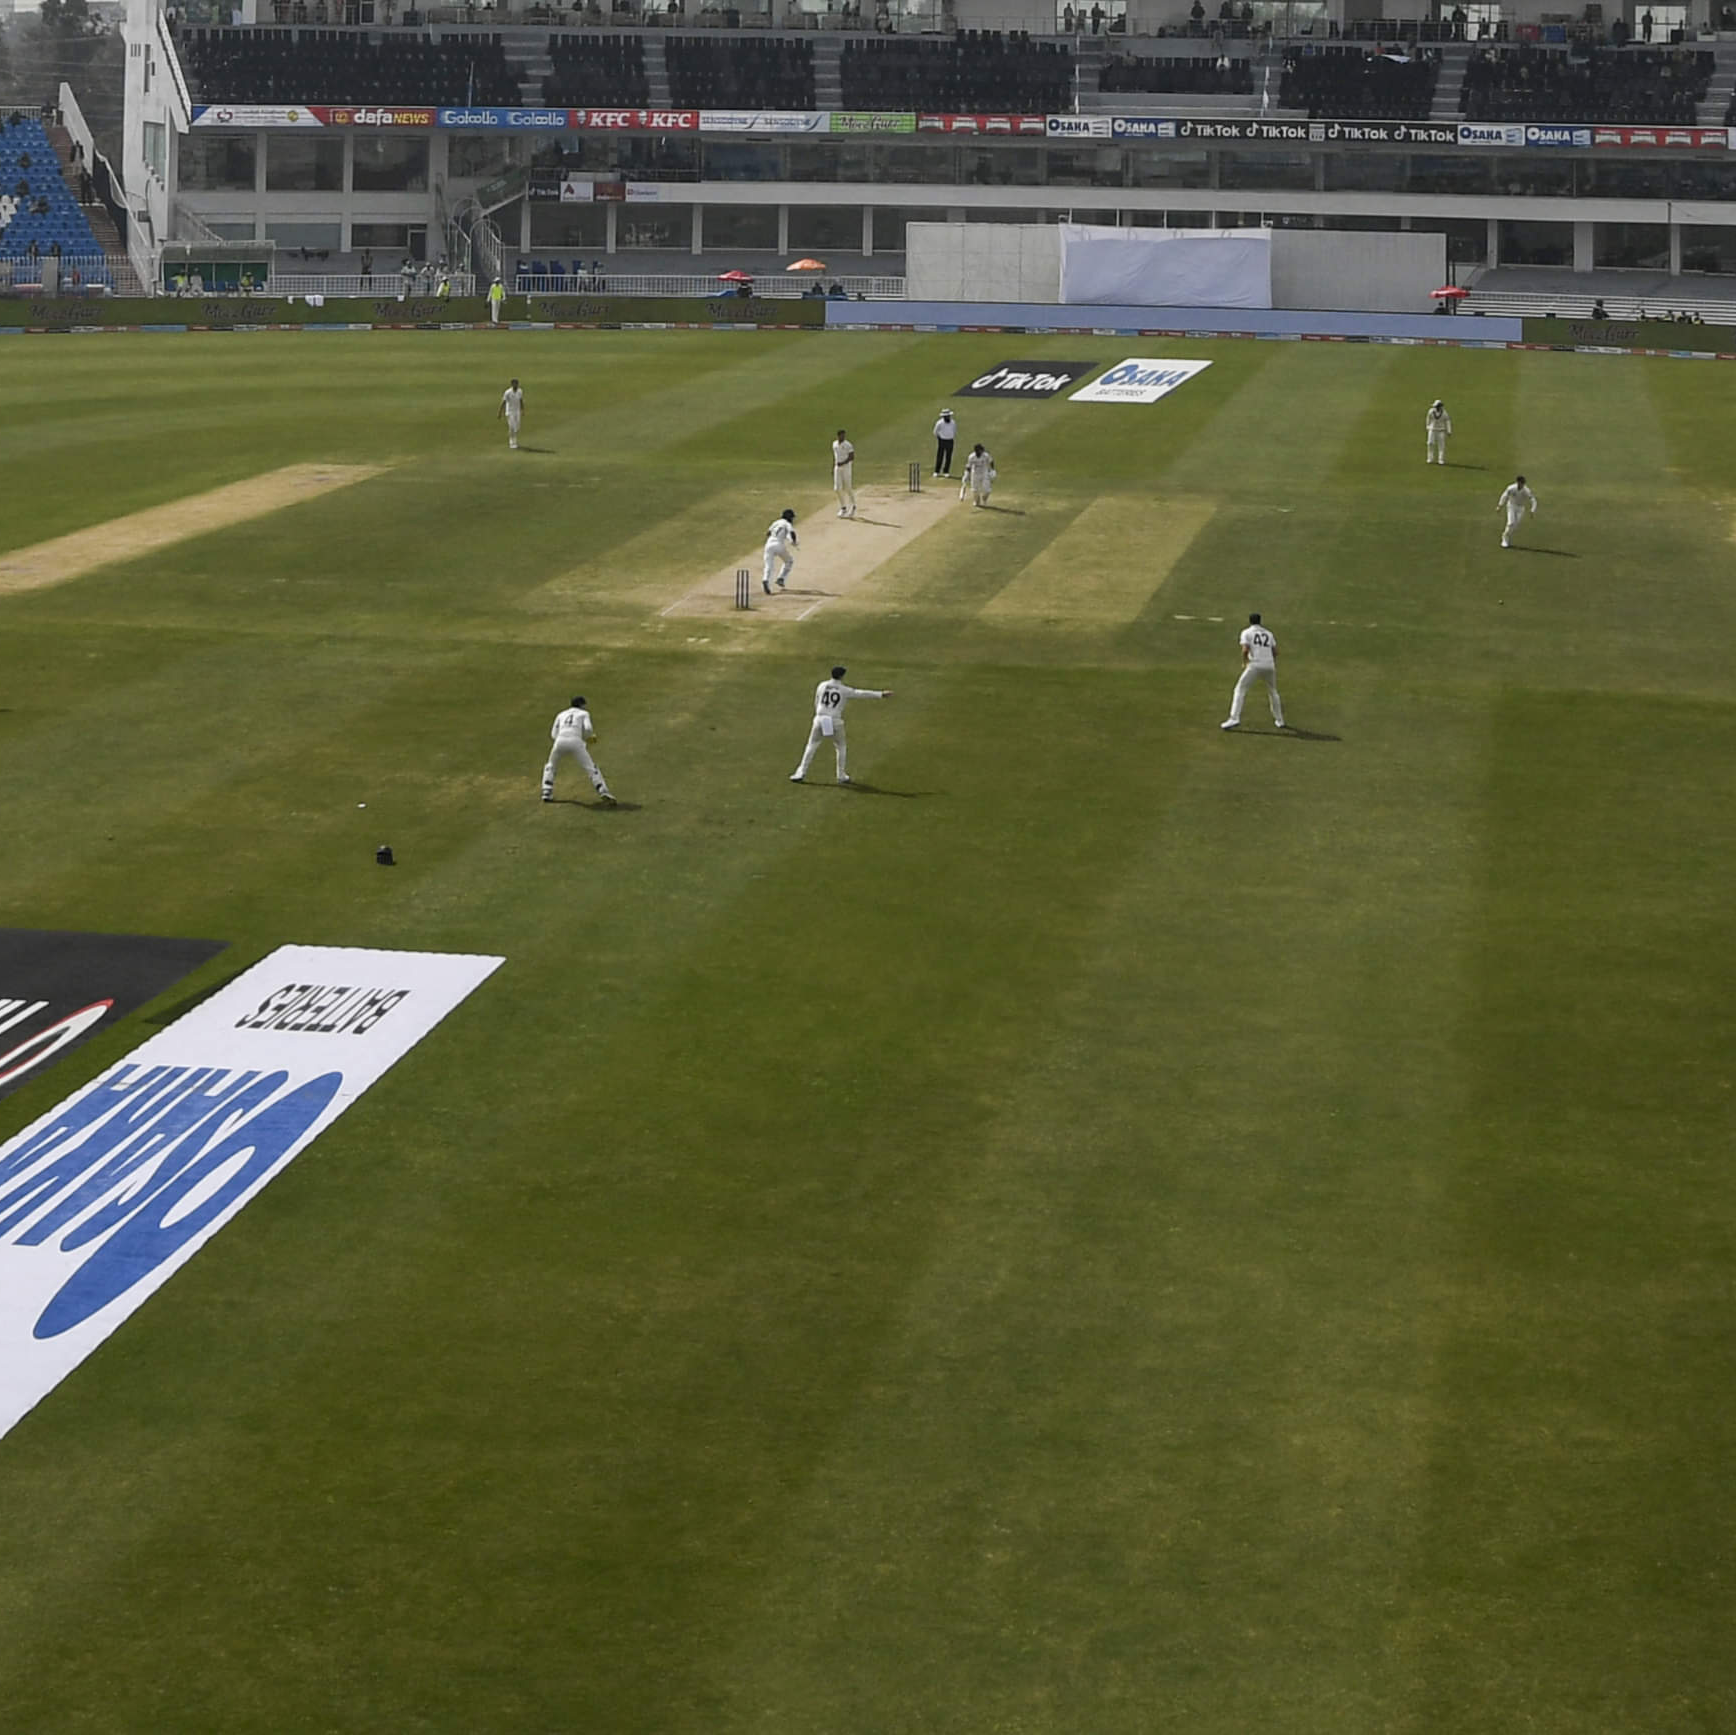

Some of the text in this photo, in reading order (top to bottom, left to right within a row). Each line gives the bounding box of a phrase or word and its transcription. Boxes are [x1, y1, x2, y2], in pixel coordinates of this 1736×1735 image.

[589, 113, 631, 127] KFC
[650, 113, 691, 128] KFC
[1048, 118, 1090, 132] OSAKA
[1114, 118, 1156, 133] OSAKA
[1195, 122, 1240, 137] TikTok
[1261, 123, 1306, 138] TikTok
[1343, 126, 1388, 140] TikTok
[1409, 128, 1455, 142] TikTok
[1460, 127, 1503, 141] OSAKA
[1527, 127, 1570, 142] OSAKA
[994, 371, 1071, 391] TikTok
[1099, 364, 1189, 386] OSAKA
[1253, 632, 1270, 647] 42
[821, 691, 841, 708] 49
[564, 714, 573, 726] 4
[235, 983, 411, 1035] BATTERIES
